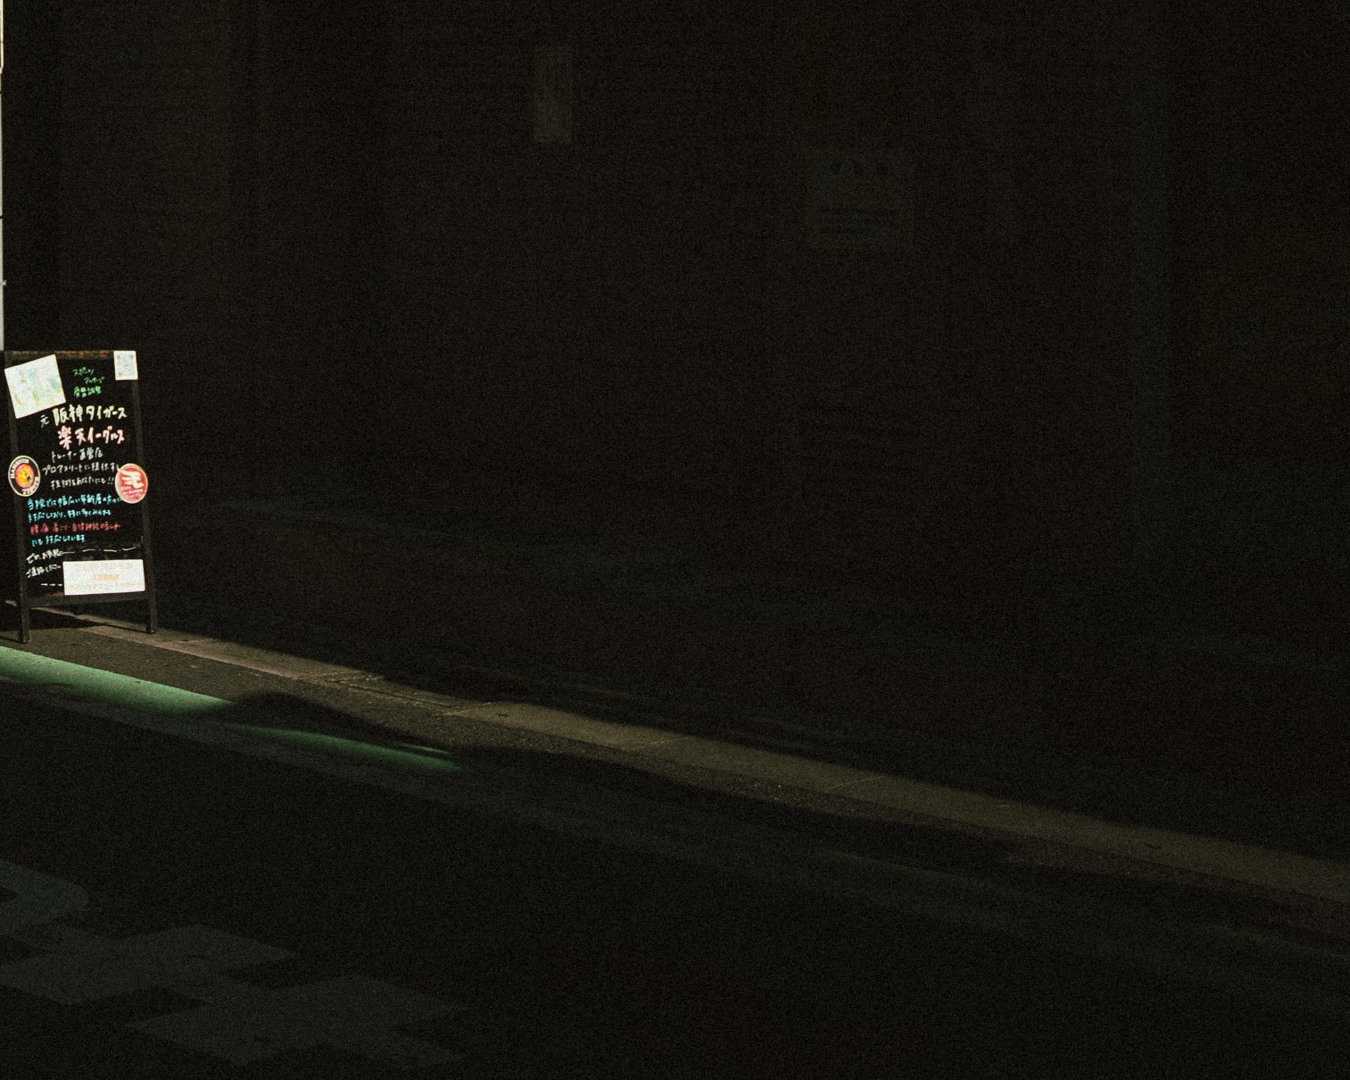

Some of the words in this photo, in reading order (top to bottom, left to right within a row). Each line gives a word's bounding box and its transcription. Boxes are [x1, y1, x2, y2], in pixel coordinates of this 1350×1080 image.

[57, 425, 126, 451] 楽天イーグルス
